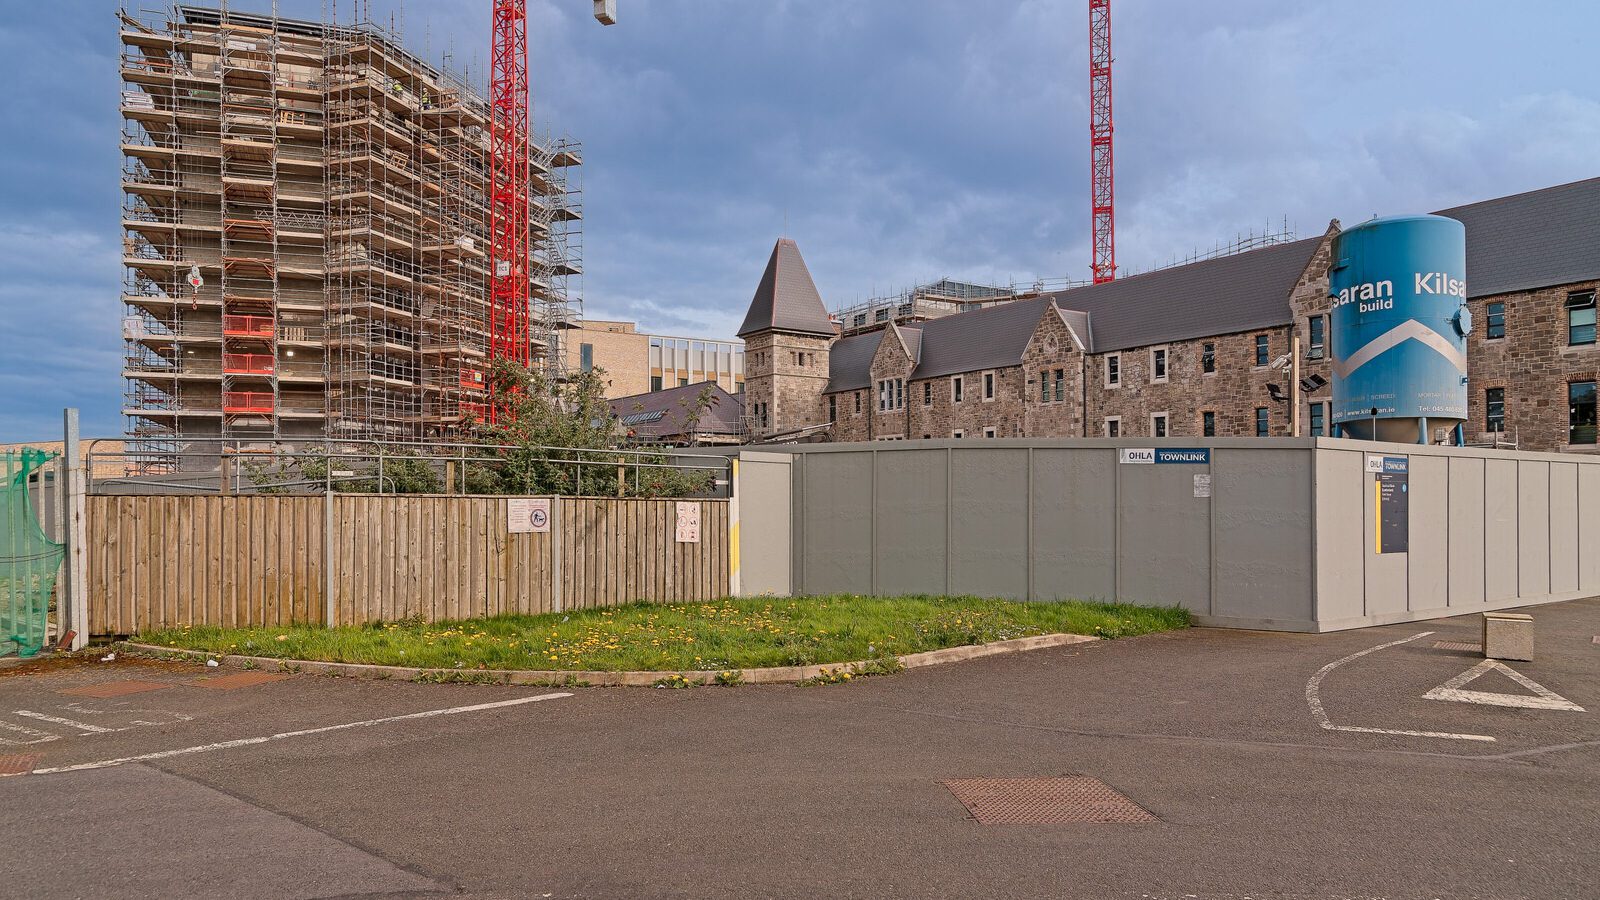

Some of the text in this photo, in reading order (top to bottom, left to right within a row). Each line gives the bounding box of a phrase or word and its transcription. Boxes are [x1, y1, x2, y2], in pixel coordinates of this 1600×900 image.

[1359, 298, 1393, 313] build
[1128, 452, 1153, 460] OHLA
[1159, 453, 1206, 461] TOWNLINK
